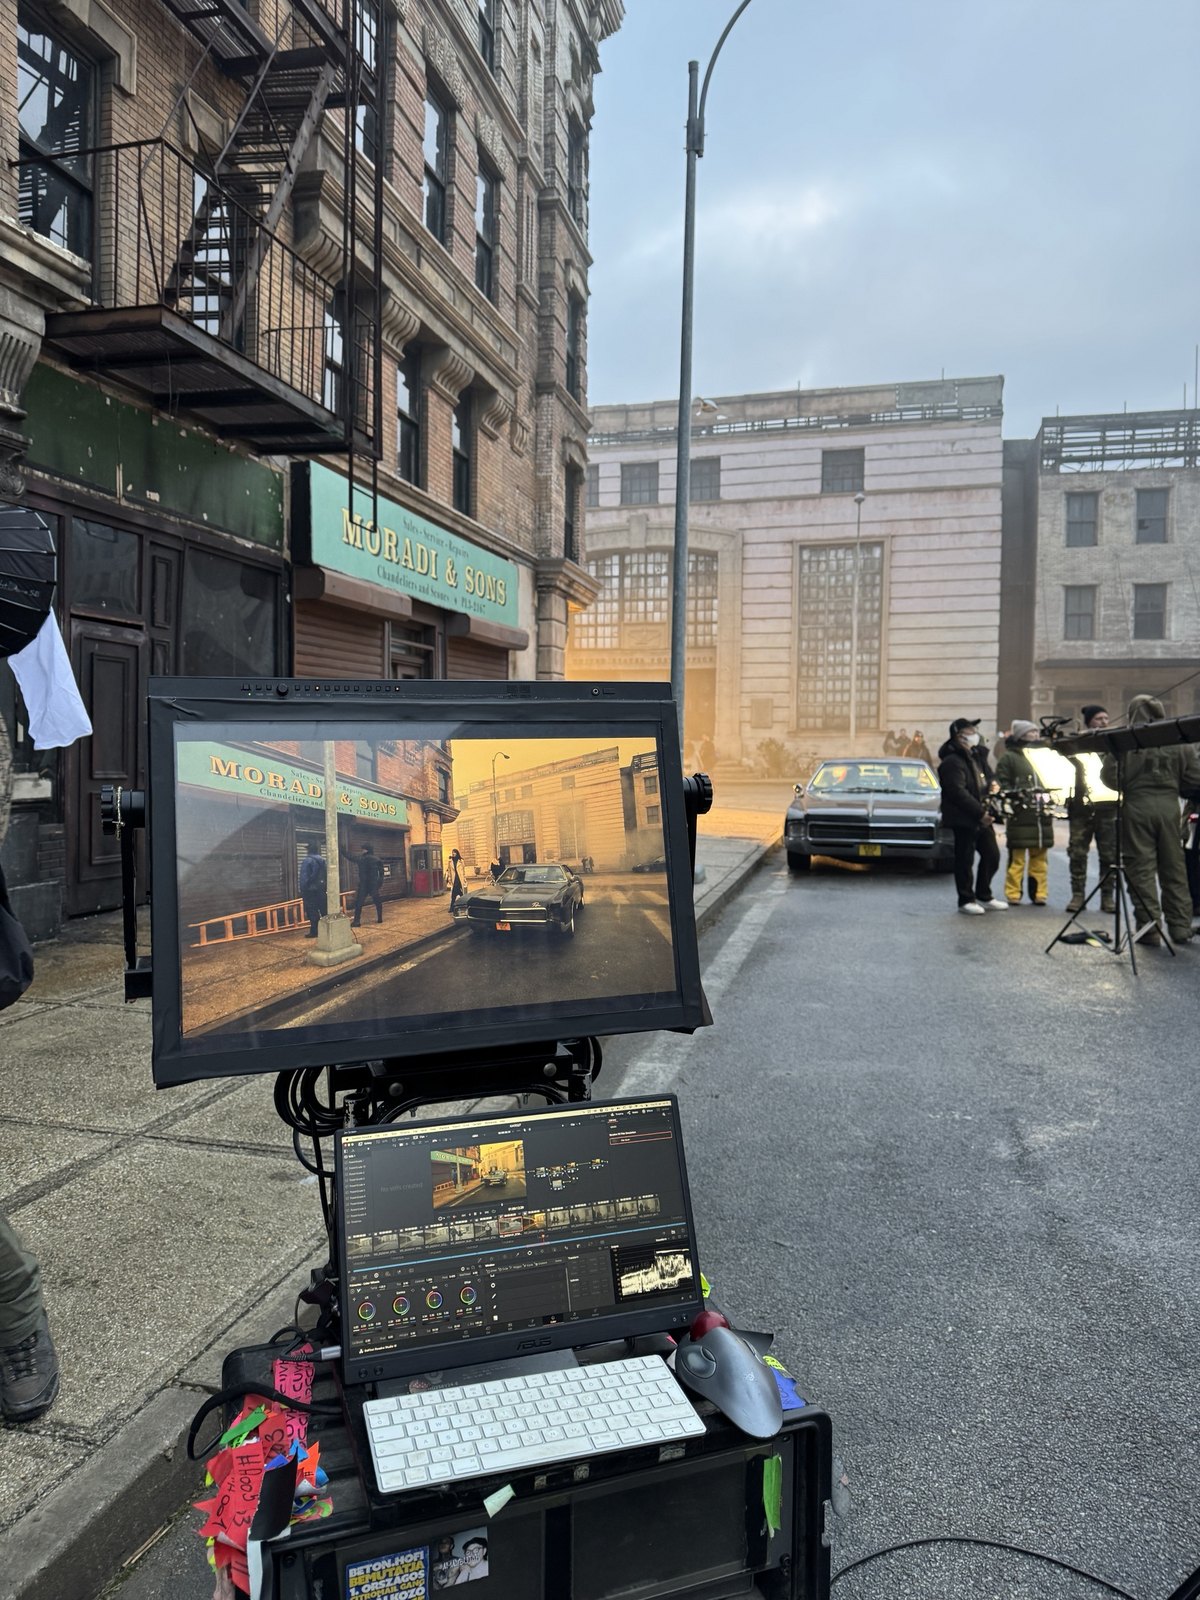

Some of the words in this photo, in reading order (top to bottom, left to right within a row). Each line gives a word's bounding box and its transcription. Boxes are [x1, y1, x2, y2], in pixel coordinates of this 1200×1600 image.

[342, 507, 438, 580] MORADI
[446, 558, 458, 588] &
[465, 566, 507, 606] SONS
[377, 564, 418, 591] Chandeliers
[418, 580, 430, 596] and
[209, 754, 323, 798] MORAD
[340, 792, 352, 806] &
[360, 797, 397, 816] SONS
[291, 769, 310, 781] Sales
[260, 787, 310, 804] Chandeliers
[310, 798, 323, 807] and
[516, 1337, 552, 1352] ASUS
[349, 1550, 424, 1577] BETON.HOFI
[349, 1560, 425, 1588] BEMUTATJA
[350, 1587, 359, 1596] 1.
[400, 1578, 425, 1590] GANG
